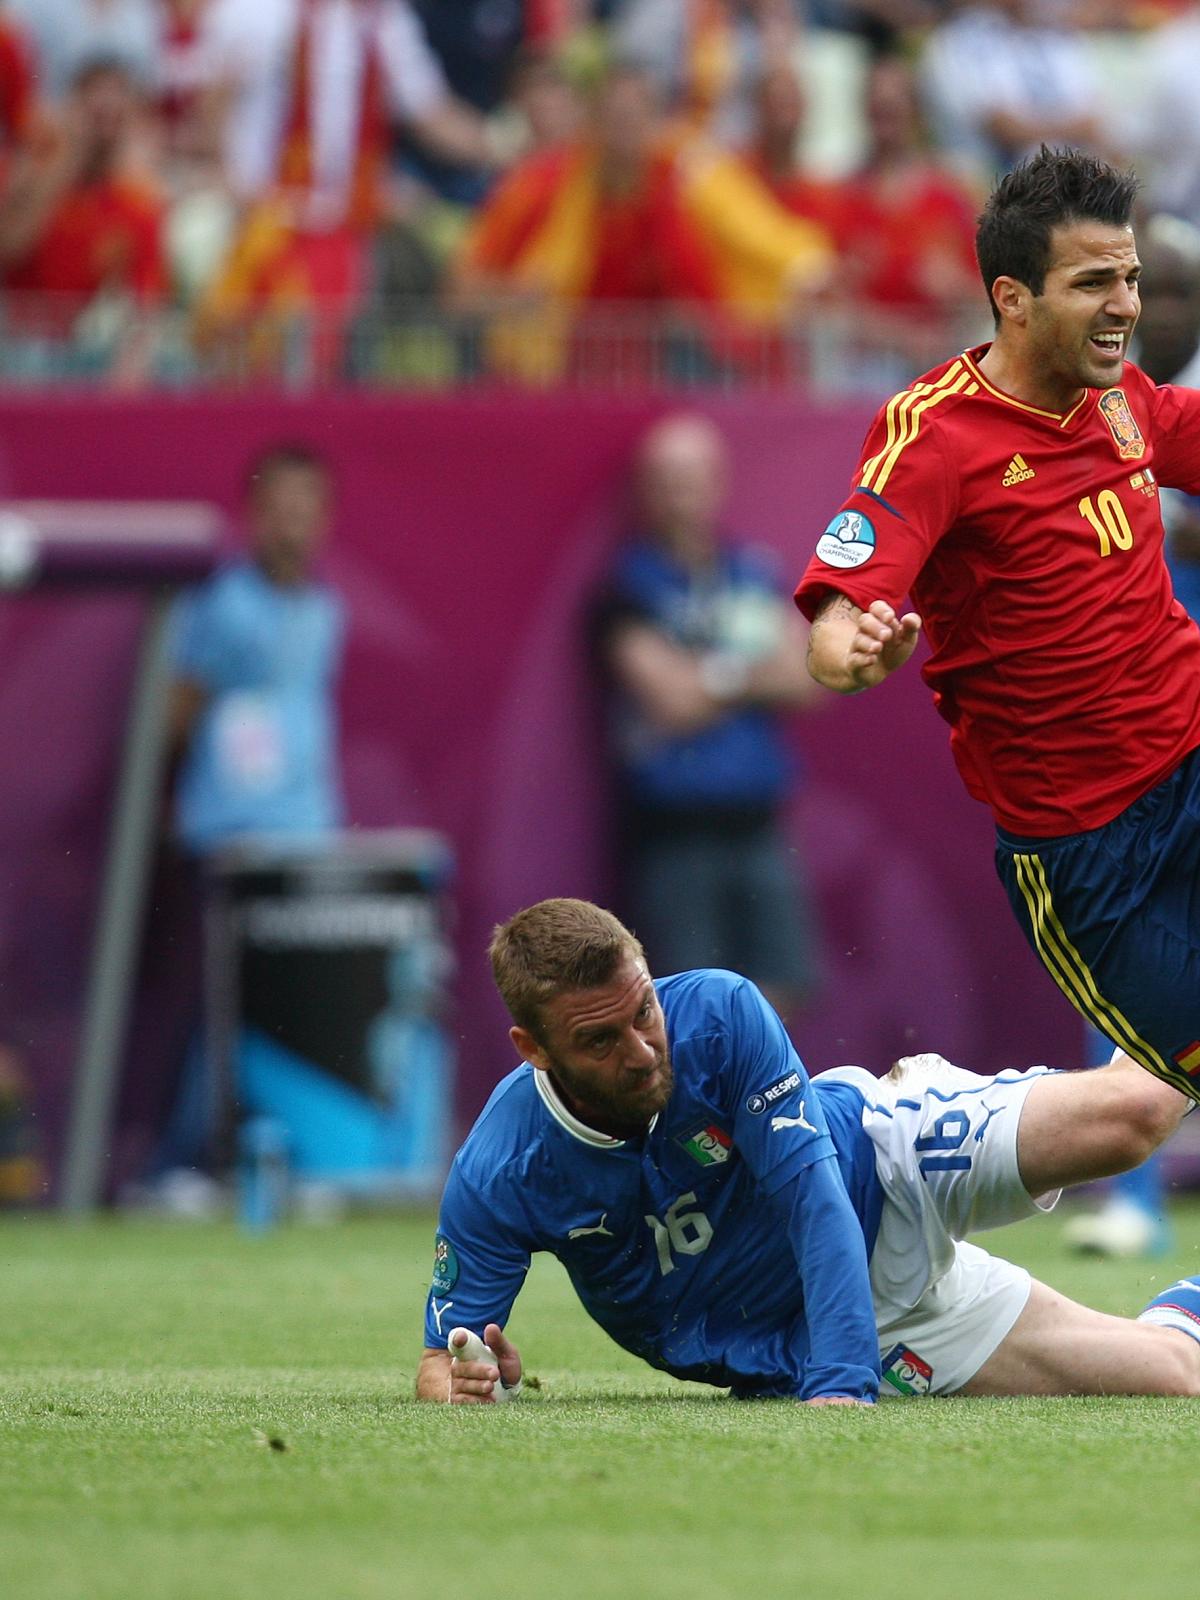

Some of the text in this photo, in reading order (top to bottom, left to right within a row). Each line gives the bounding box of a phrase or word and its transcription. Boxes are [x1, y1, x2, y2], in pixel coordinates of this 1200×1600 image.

[1002, 468, 1036, 487] adidas
[1078, 489, 1134, 557] 10
[913, 1110, 972, 1182] 16
[644, 1191, 714, 1277] 16
